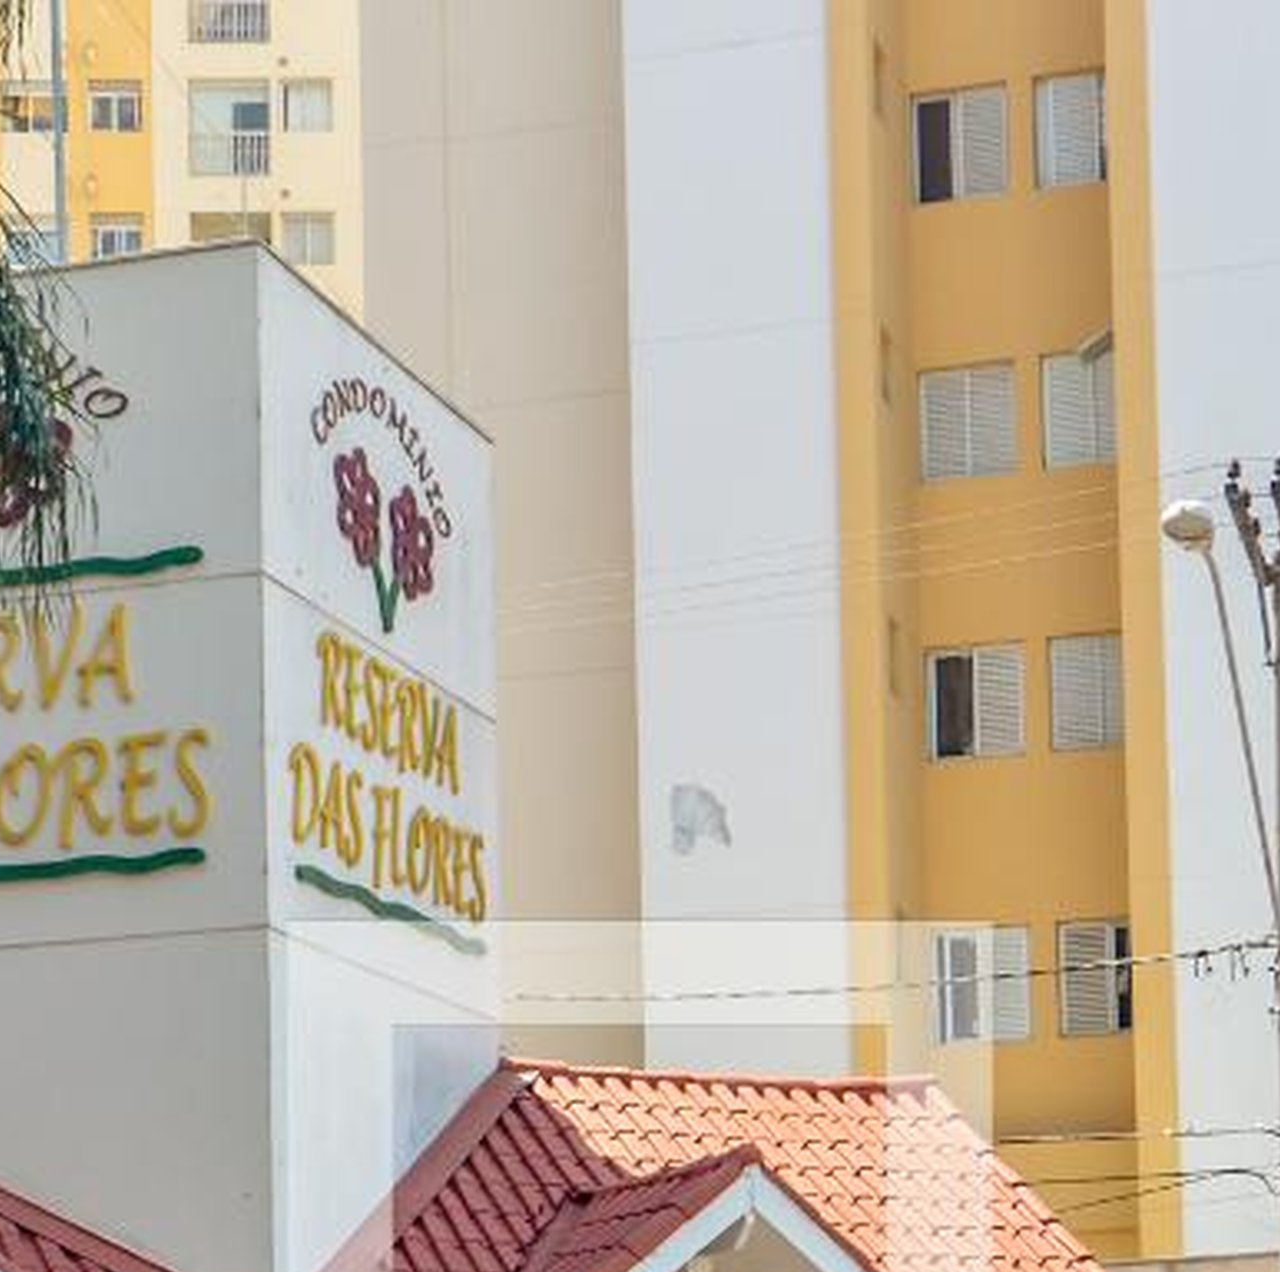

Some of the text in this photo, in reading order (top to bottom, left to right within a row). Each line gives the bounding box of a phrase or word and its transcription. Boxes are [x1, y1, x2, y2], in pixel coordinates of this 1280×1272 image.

[316, 632, 460, 796] RESERVA
[288, 741, 488, 924] DAS FLORES
